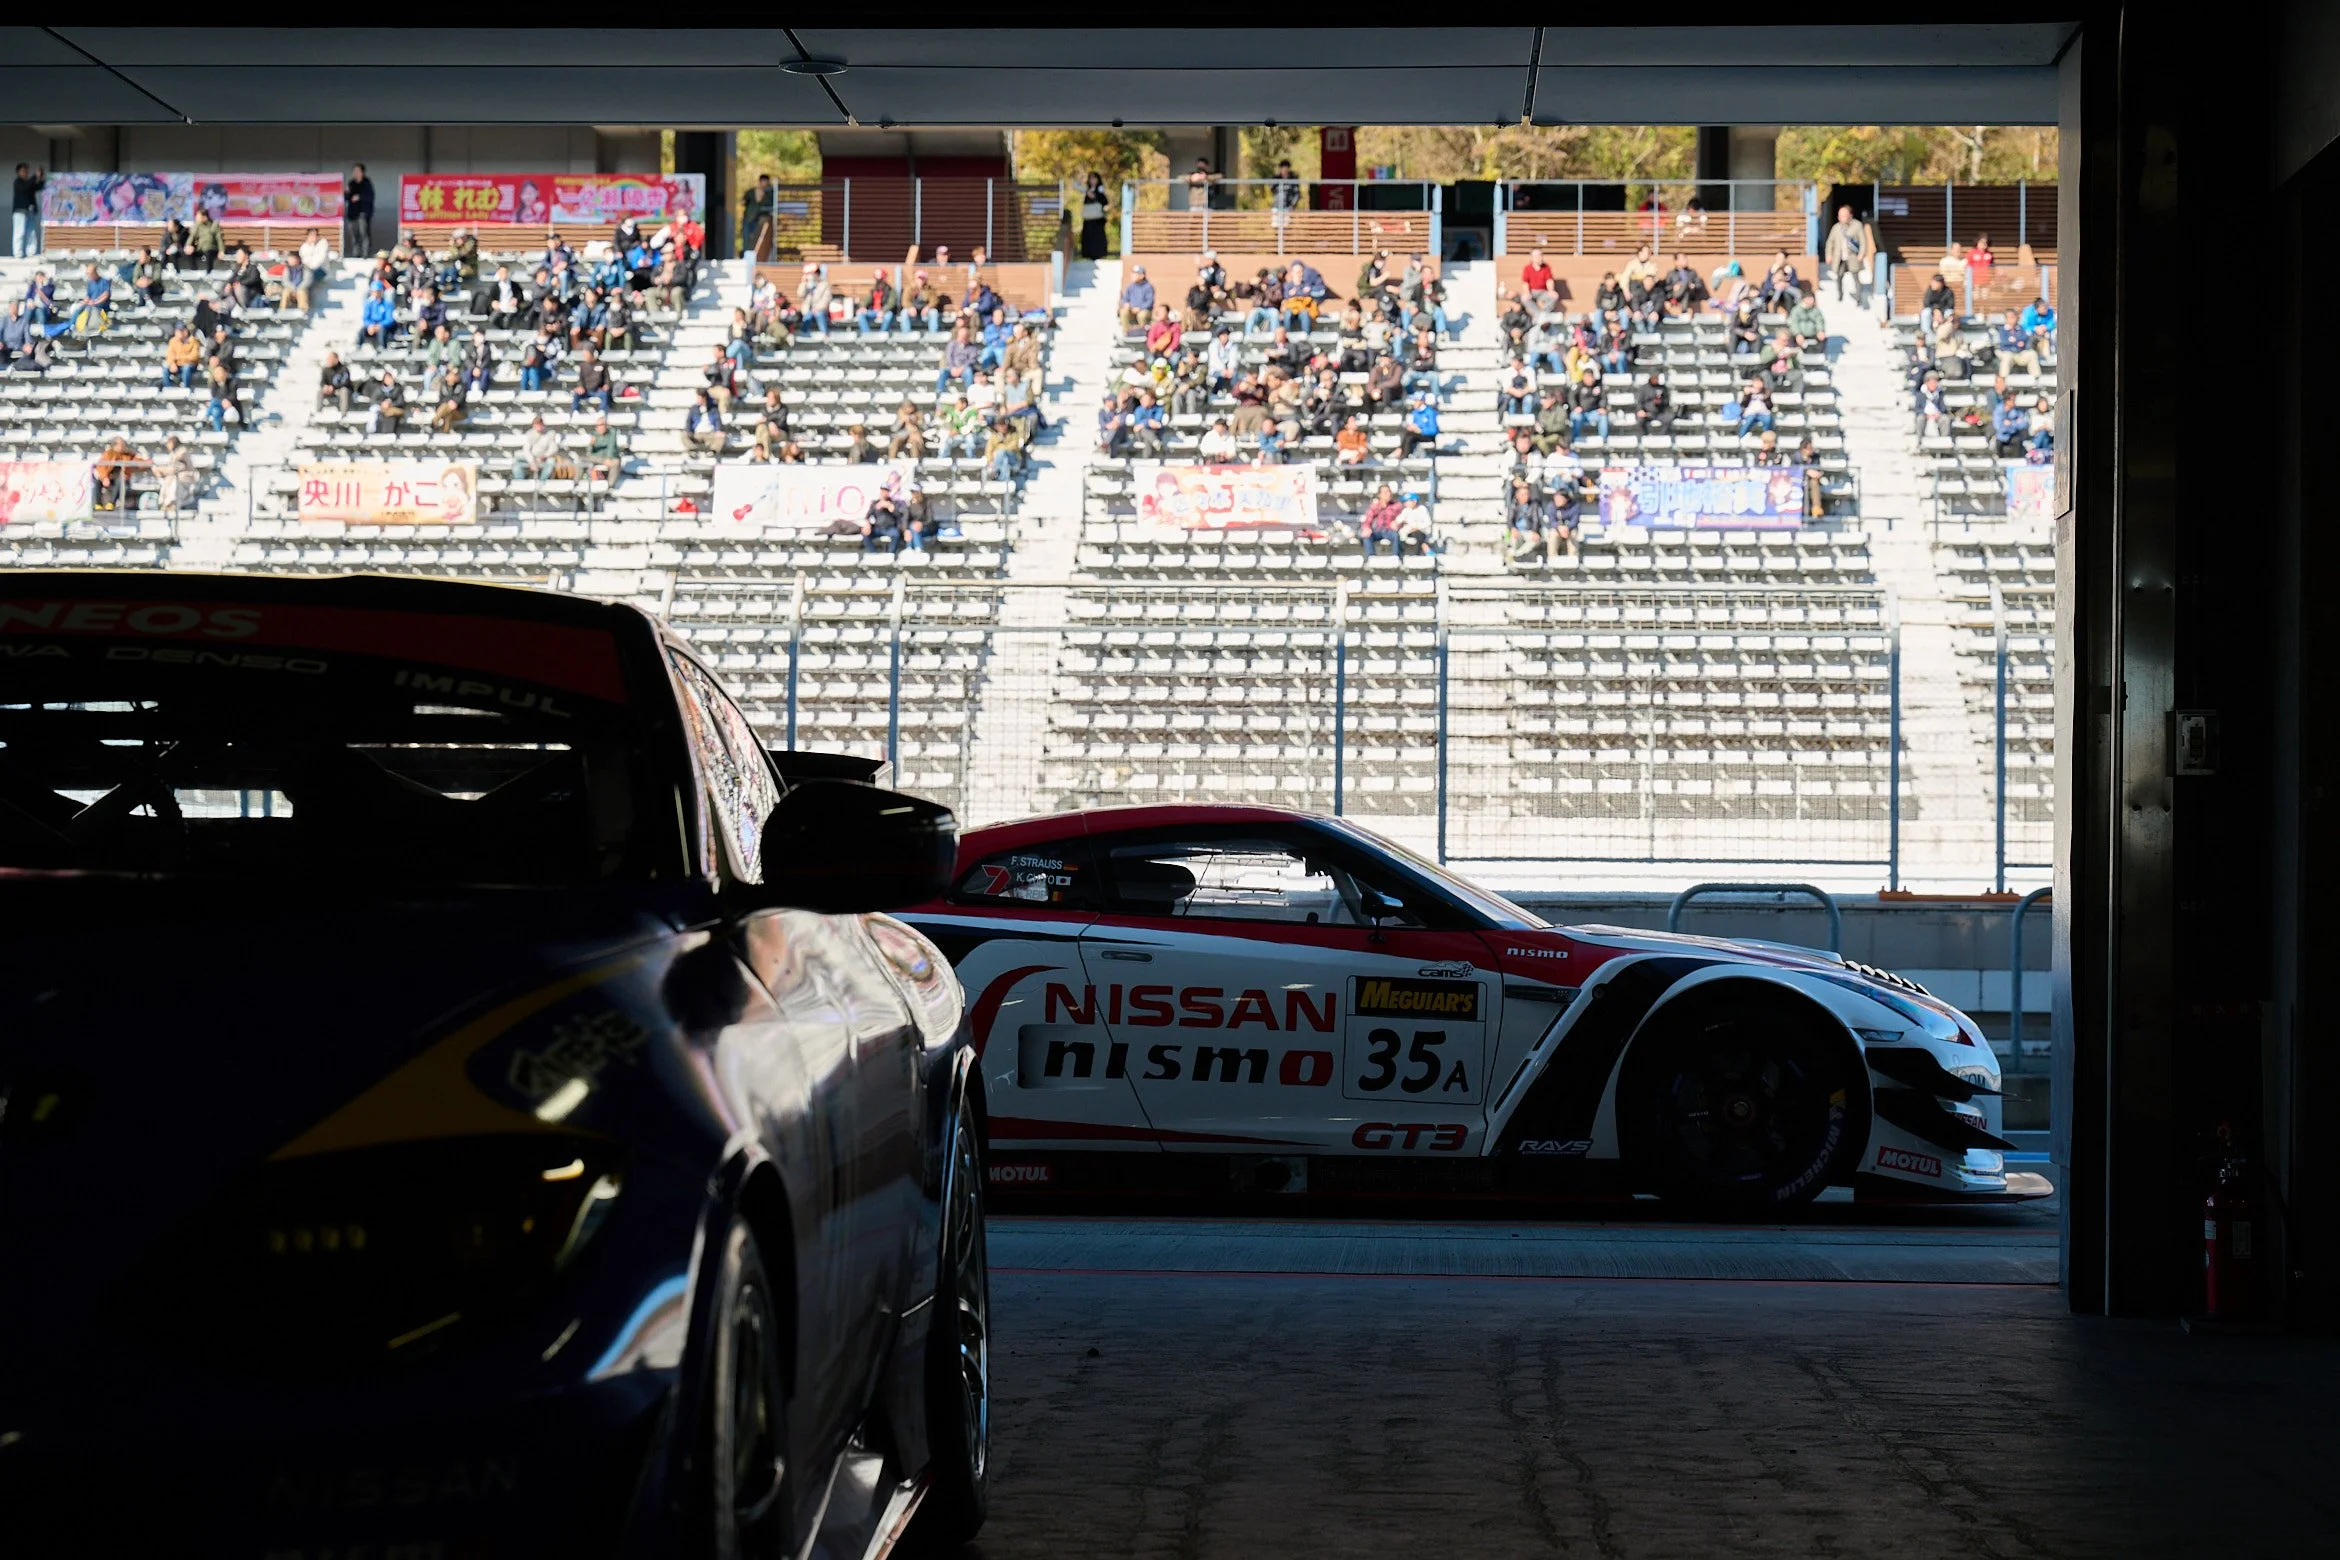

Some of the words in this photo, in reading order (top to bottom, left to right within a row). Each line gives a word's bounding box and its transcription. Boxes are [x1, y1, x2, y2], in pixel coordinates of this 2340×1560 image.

[304, 479, 361, 508] 央川
[384, 481, 439, 508] かこ
[104, 646, 330, 675] DENSO
[393, 669, 572, 719] IMPUL
[1506, 946, 1569, 960] nismo
[1045, 982, 1337, 1033] NISSAN
[1360, 980, 1474, 1013] MEGUIAR'S
[1044, 1040, 1335, 1087] nismo
[1351, 1123, 1469, 1151] GT3
[1517, 1139, 1592, 1152] RAYS
[1776, 1124, 1841, 1202] MICHELIN
[1881, 1151, 1940, 1174] MOTUL
